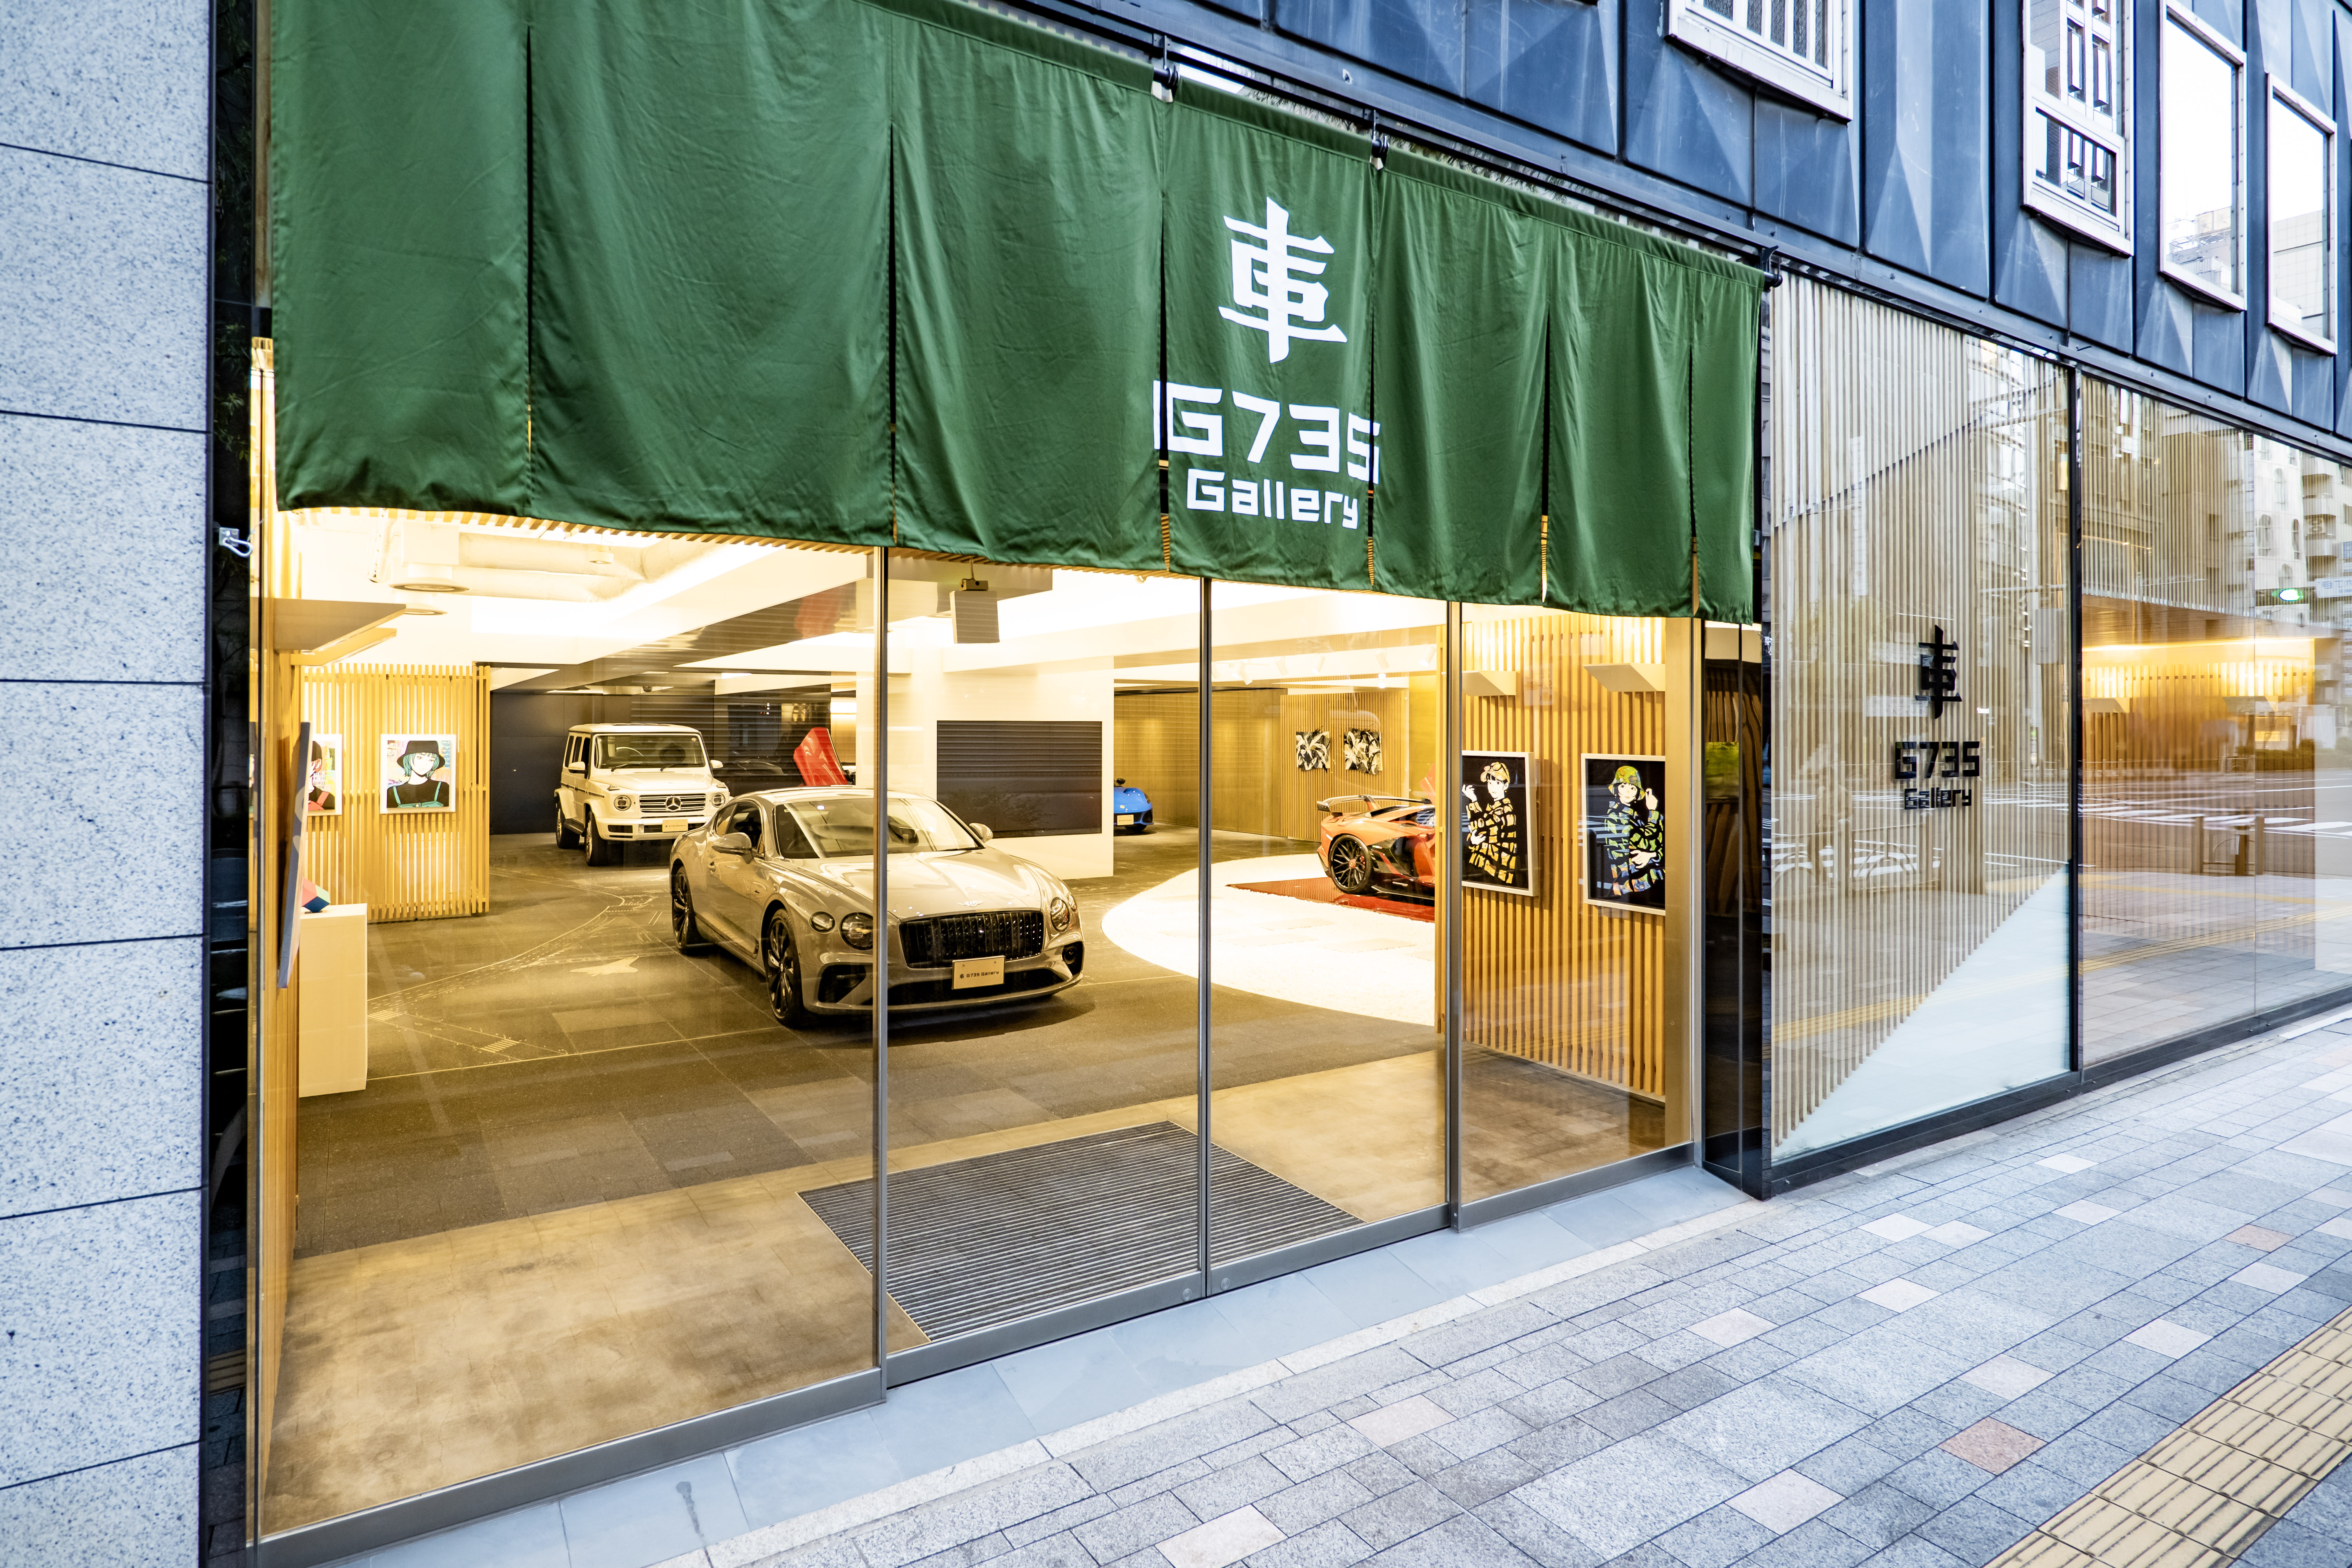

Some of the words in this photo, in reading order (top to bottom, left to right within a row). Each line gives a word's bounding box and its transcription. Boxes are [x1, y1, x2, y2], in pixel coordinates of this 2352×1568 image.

[1218, 197, 1347, 363] 車
[1153, 380, 1380, 484] G735
[1187, 468, 1358, 529] Gallery
[1915, 625, 1962, 719] 車
[1895, 741, 1980, 779] G735
[1904, 787, 1972, 810] Gallery
